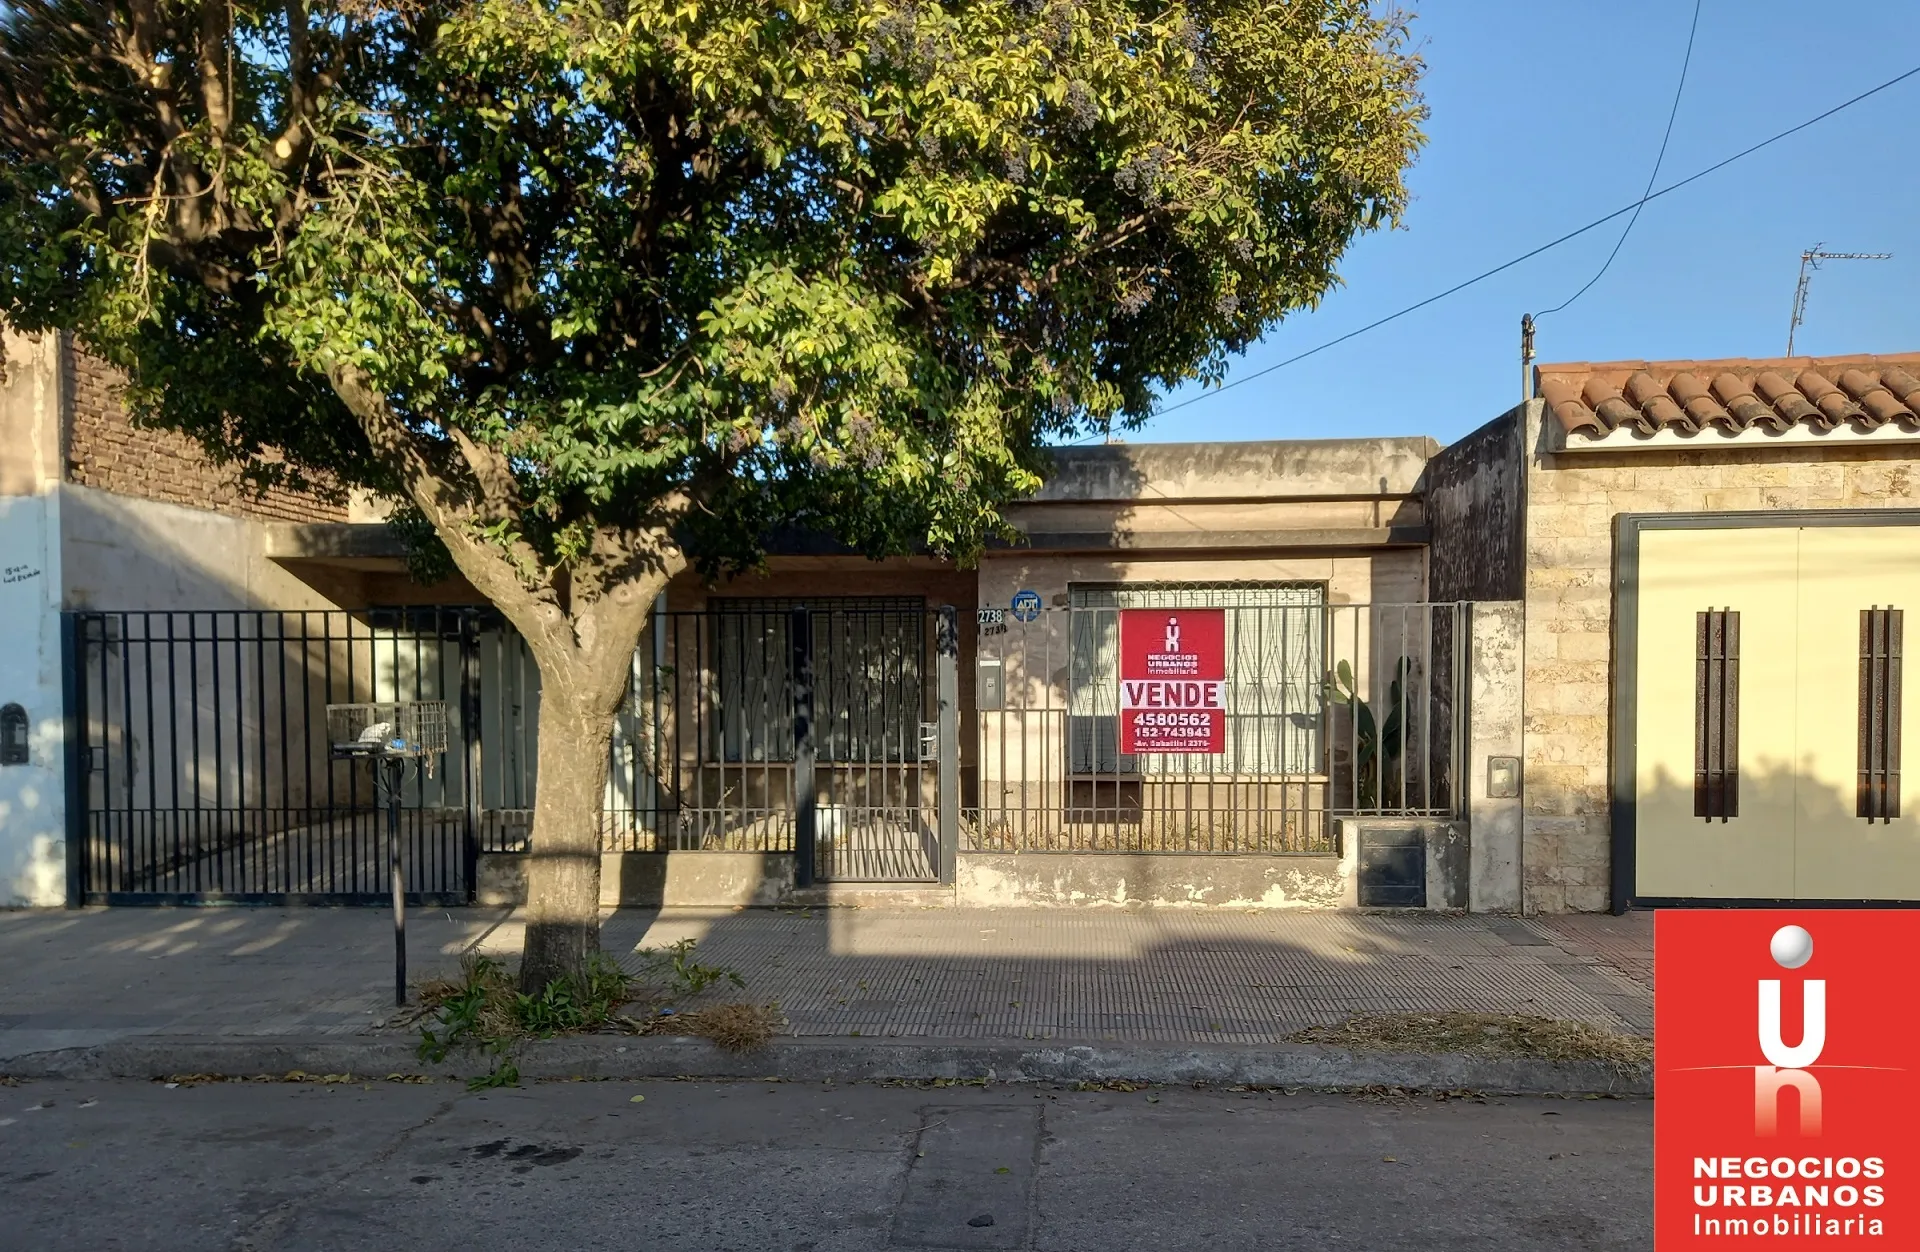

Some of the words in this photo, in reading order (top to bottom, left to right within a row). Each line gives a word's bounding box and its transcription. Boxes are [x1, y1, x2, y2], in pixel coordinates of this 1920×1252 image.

[1017, 599, 1037, 611] ADT
[978, 610, 1003, 623] 2738
[1147, 667, 1198, 675] Inmobiliaria
[1126, 682, 1218, 708] VENDE
[1133, 712, 1211, 726] 4580562
[1134, 727, 1211, 738] 152-743943
